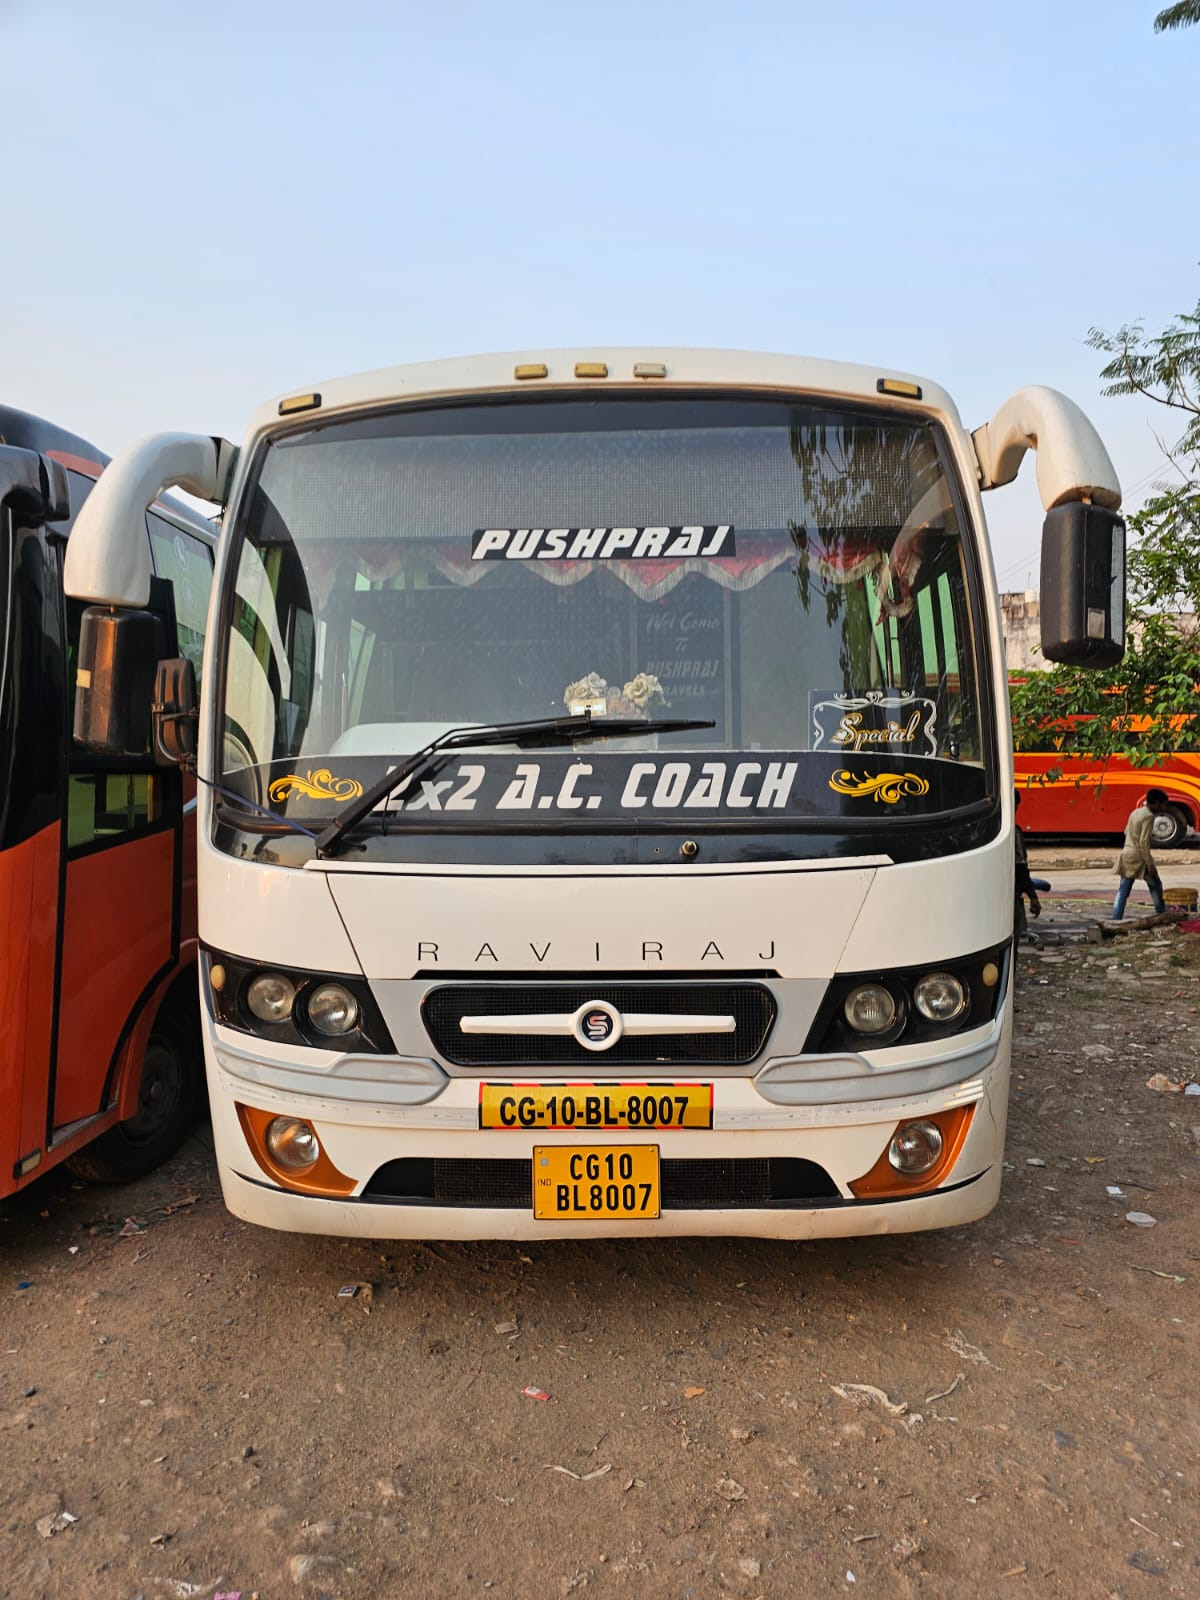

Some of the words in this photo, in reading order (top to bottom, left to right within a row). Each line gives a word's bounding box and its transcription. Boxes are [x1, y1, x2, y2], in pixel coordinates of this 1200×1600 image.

[472, 525, 731, 560] PUSHPRAJ
[646, 659, 720, 679] PUSHPRAJ
[661, 684, 705, 697] RAVELS
[829, 710, 921, 752] Special
[495, 763, 602, 810] A.C.
[620, 762, 799, 809] COACH
[417, 940, 776, 962] RAVIRAJ
[500, 1095, 689, 1126] CG-10-BL-8007
[570, 1153, 633, 1180] CG10
[557, 1183, 652, 1211] BL8007
